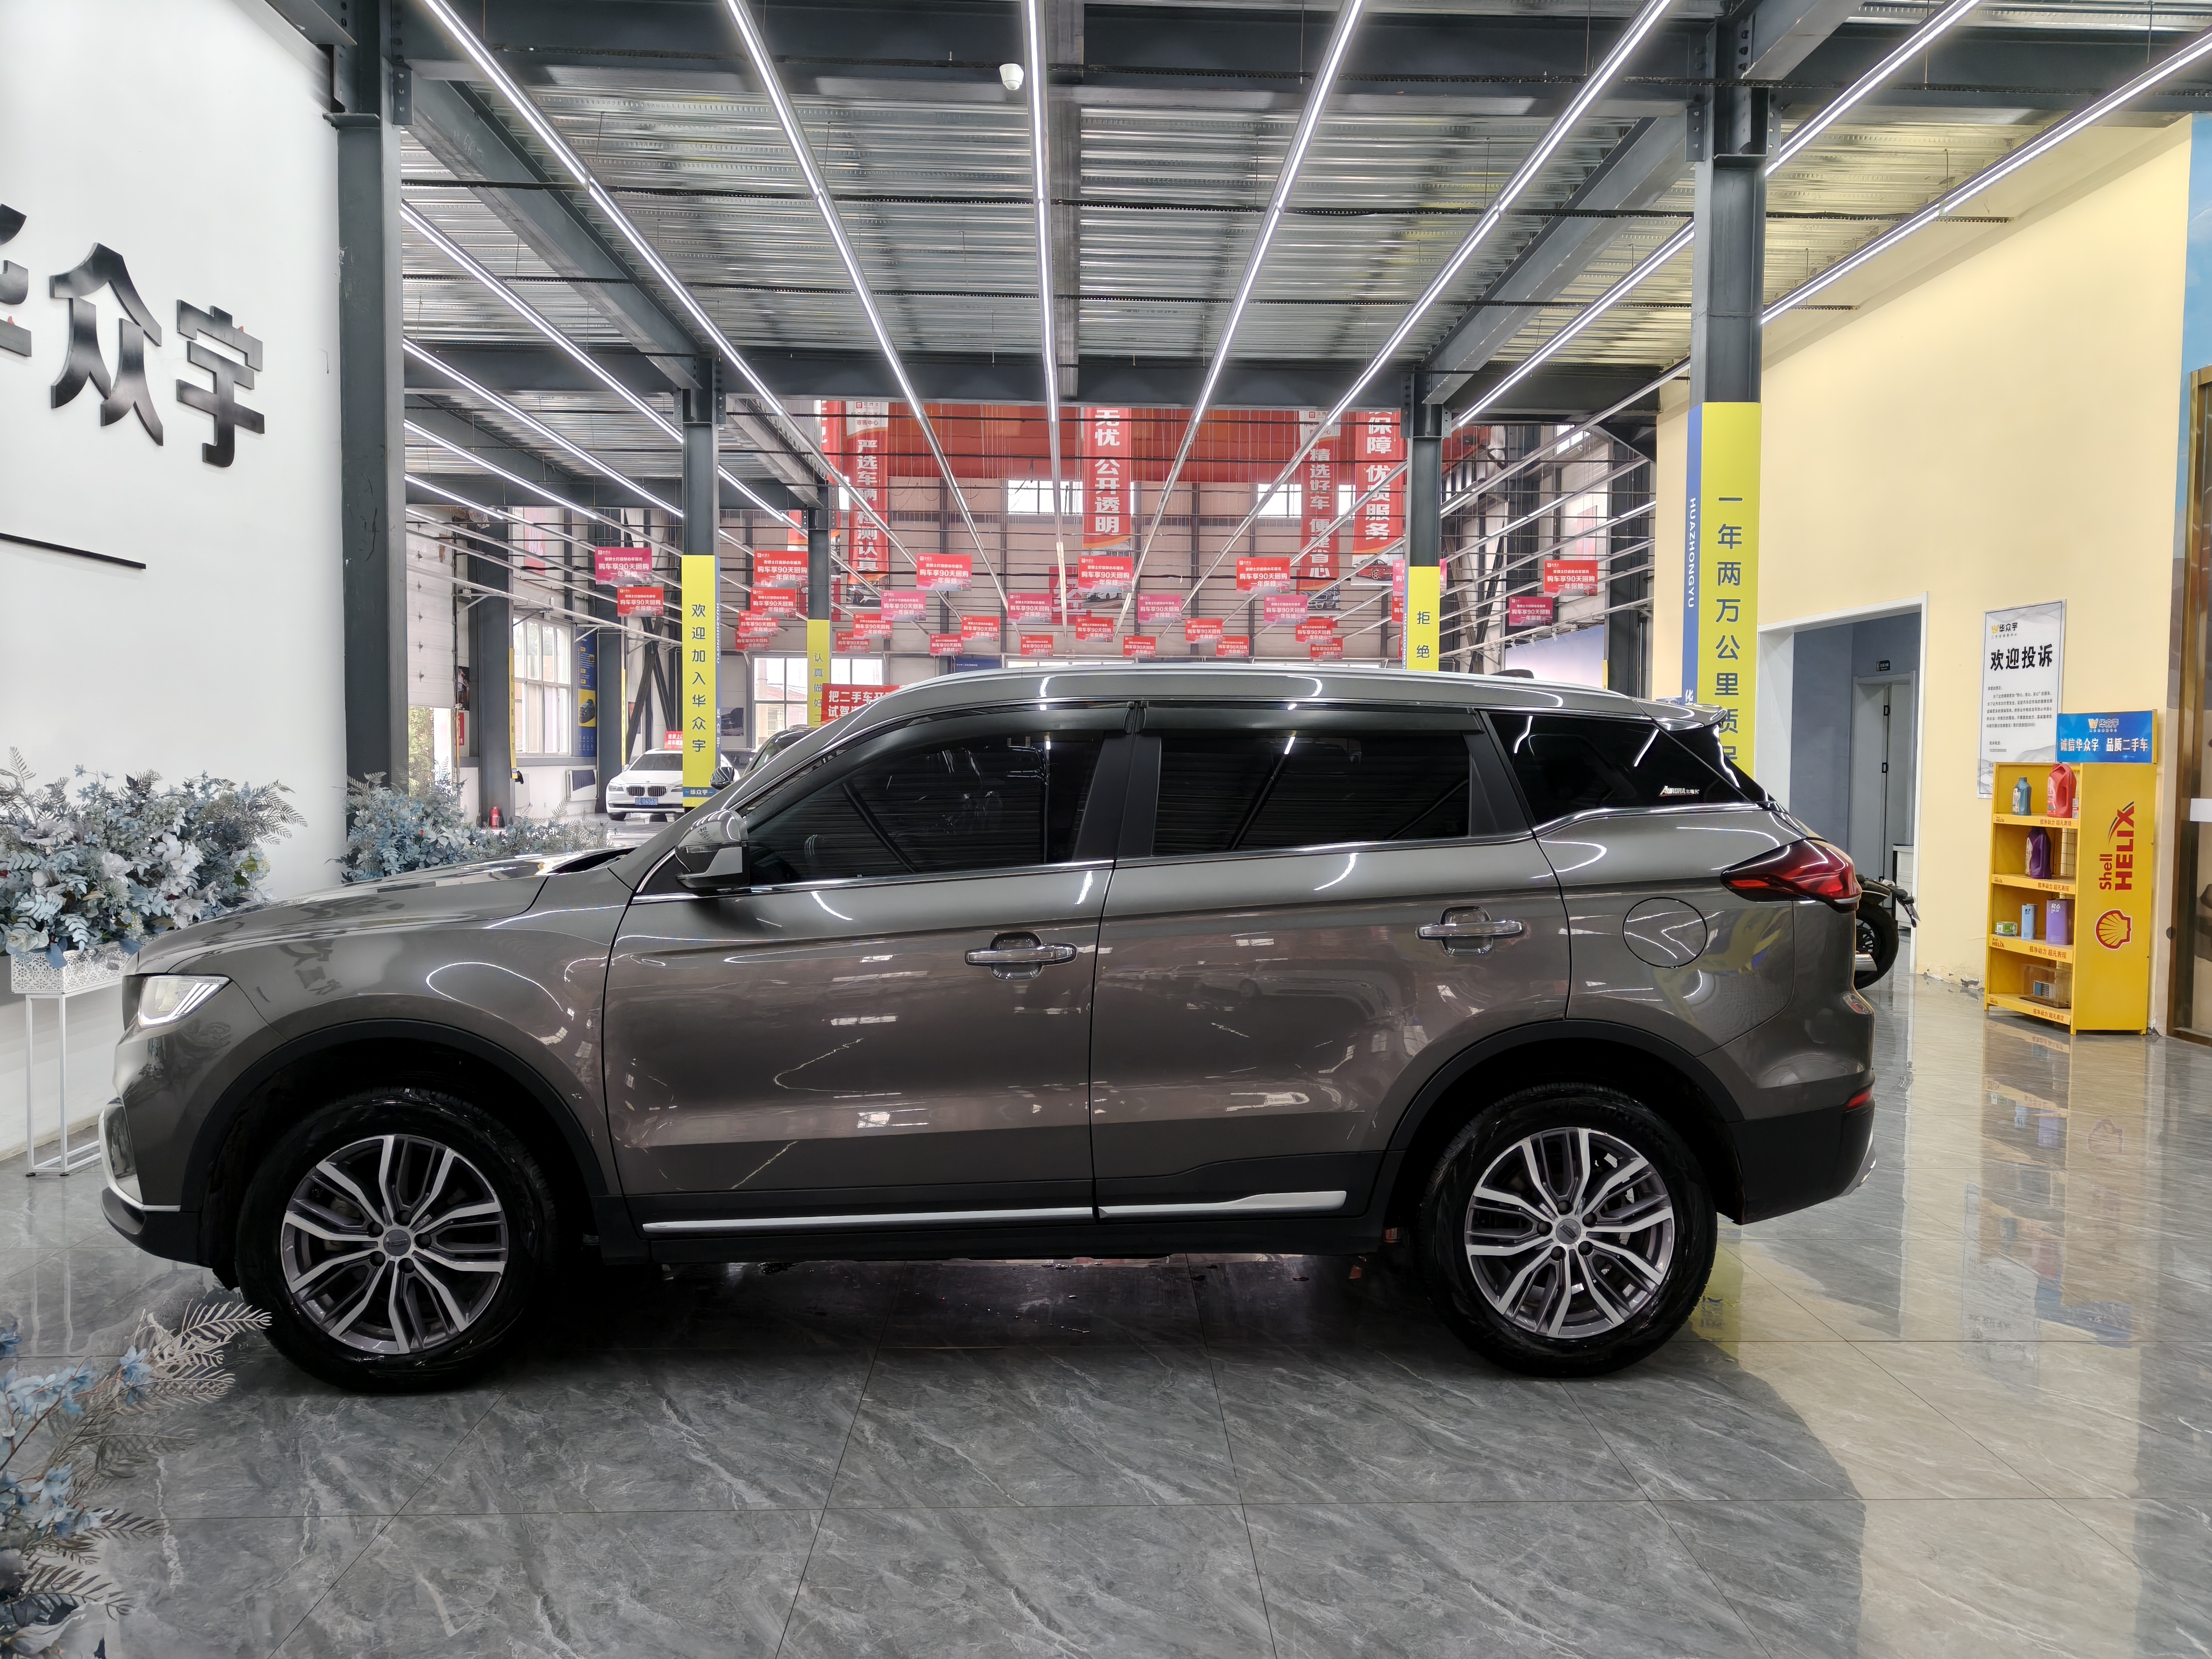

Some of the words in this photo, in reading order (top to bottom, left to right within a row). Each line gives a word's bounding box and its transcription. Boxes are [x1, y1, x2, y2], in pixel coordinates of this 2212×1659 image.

[1095, 409, 1120, 447] 无忧
[1366, 412, 1392, 454] 保障
[1095, 459, 1120, 534] 公开透明
[1310, 448, 1330, 509] 精选好车
[1687, 497, 1696, 608] HUAZHONGYU
[1416, 611, 1431, 658] 拒绝
[1999, 622, 2018, 632] 华众宇
[1990, 643, 2053, 671] 欢迎投诉
[691, 603, 706, 753] 欢迎加入华众宇
[828, 690, 892, 704] 把二手车开
[828, 705, 862, 718] 试驾
[2060, 738, 2099, 752] 诚信华众宇
[2106, 737, 2148, 752] 品质二手车
[1660, 785, 1686, 795] AURORA
[2108, 802, 2134, 891] HELIX
[2099, 854, 2113, 890] Shell
